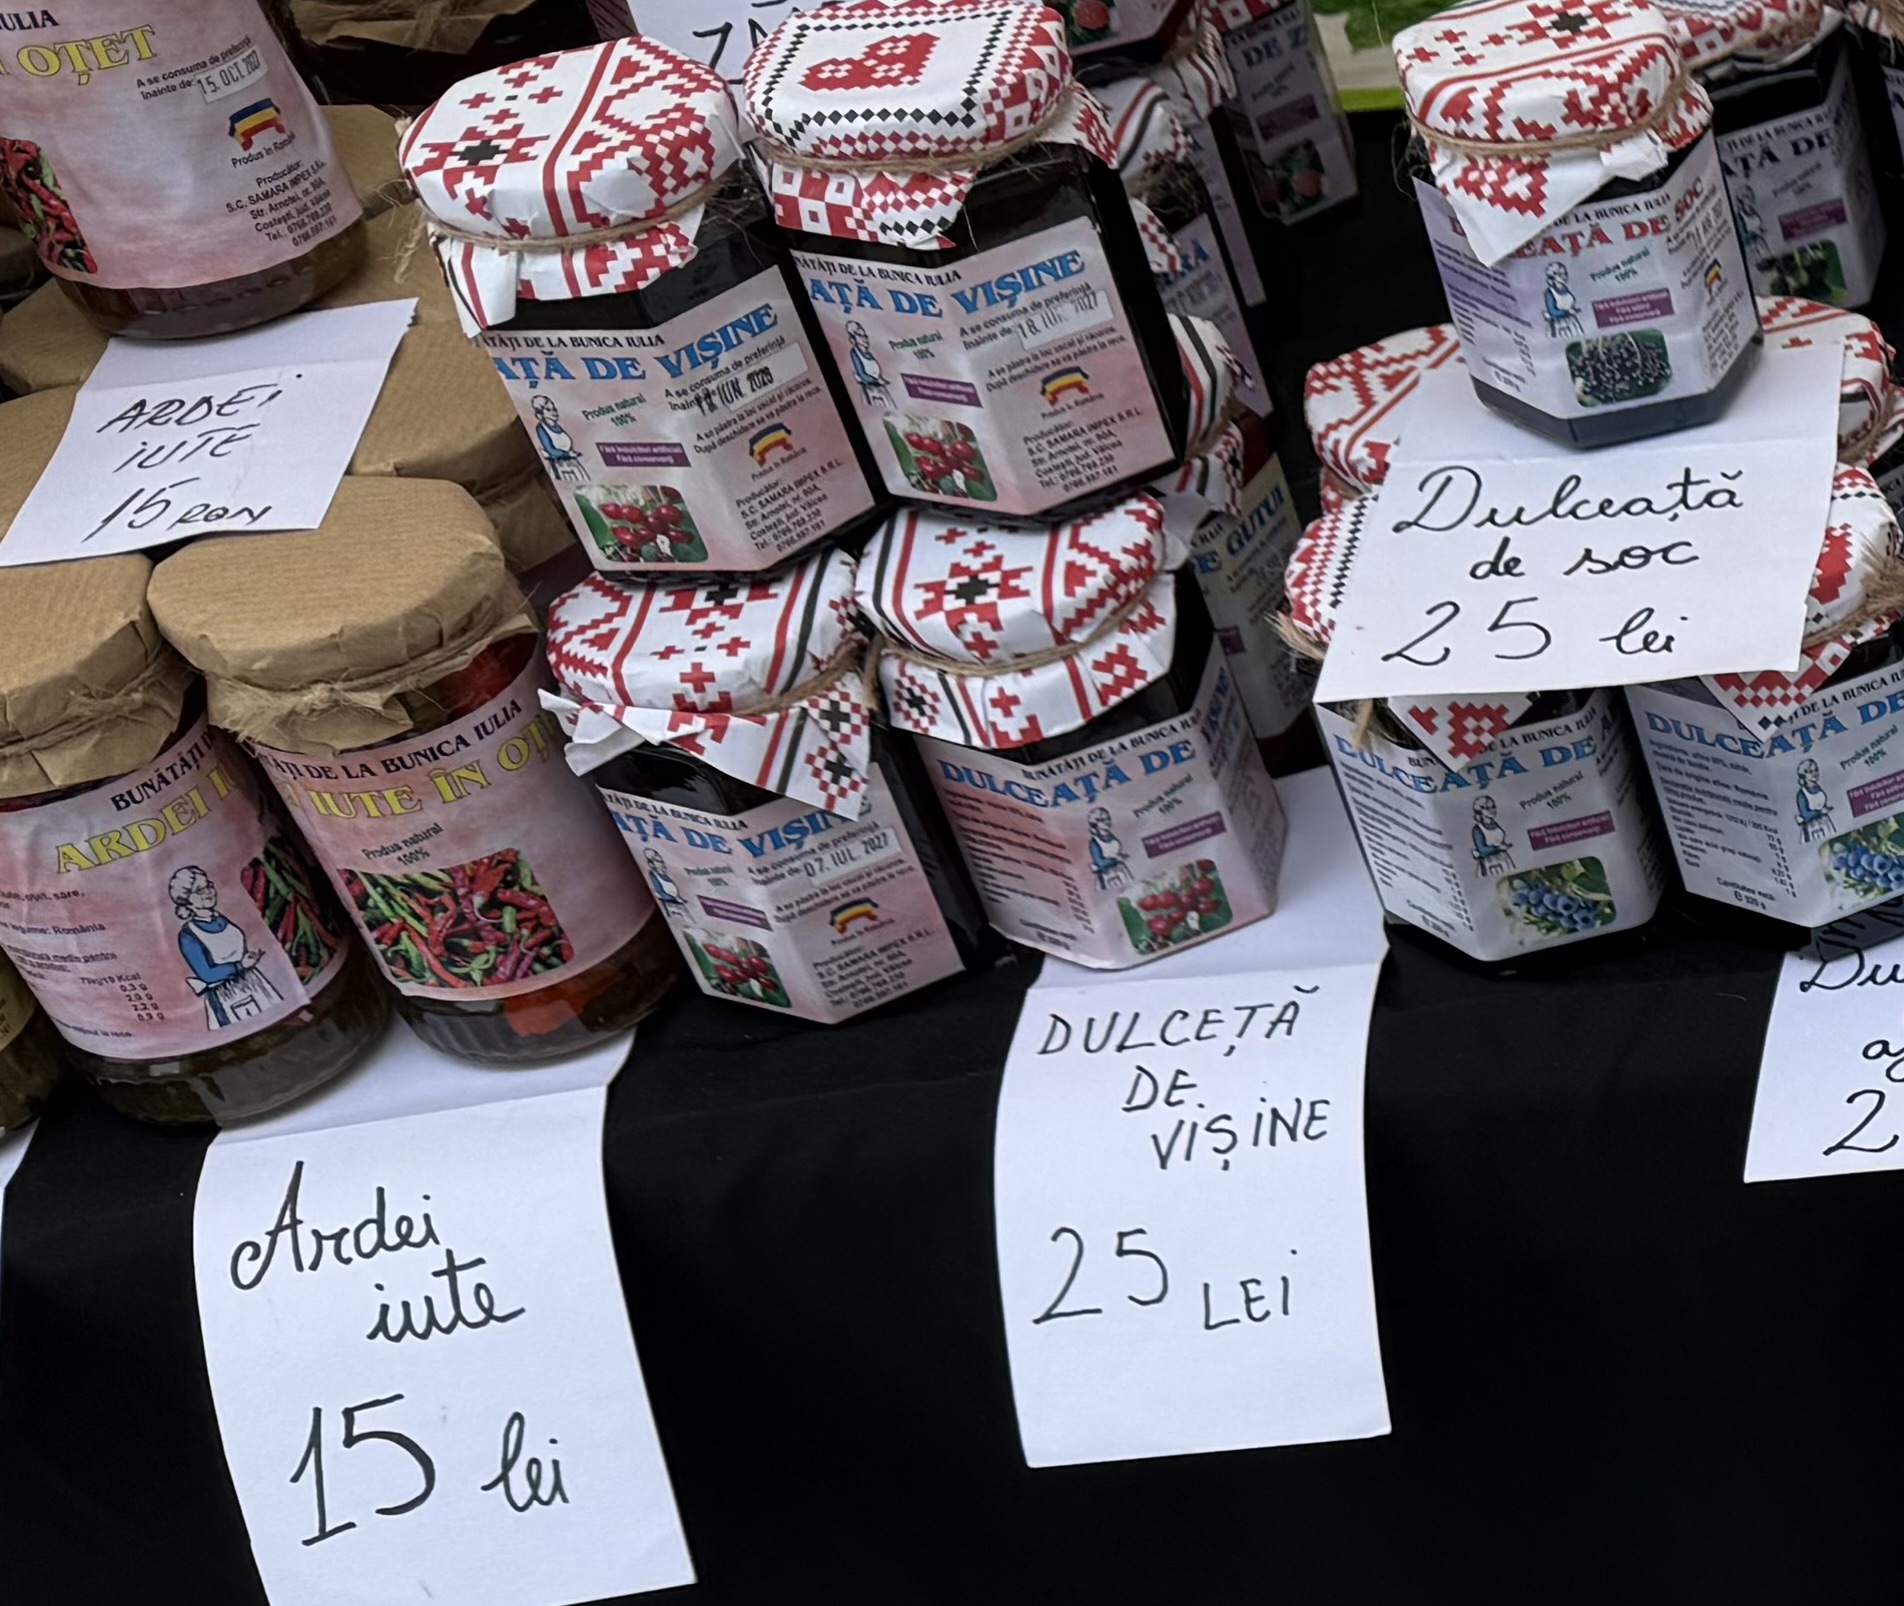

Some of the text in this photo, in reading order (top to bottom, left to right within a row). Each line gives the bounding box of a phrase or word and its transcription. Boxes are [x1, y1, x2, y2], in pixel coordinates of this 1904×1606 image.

[16, 24, 157, 87] OȚET
[888, 248, 1086, 319] DE VIȘINE
[580, 302, 780, 382] DE VIȘINE
[625, 333, 666, 349] IULIA
[80, 476, 274, 543] 15 RON
[1391, 464, 1745, 534] Dulceață
[1469, 535, 1701, 581] de soc
[1380, 596, 1690, 667] 25 lei
[382, 698, 525, 774] BUNICA IULIA
[1645, 709, 1849, 760] DULCEAȚĂ
[431, 760, 493, 805] ÎN
[937, 739, 1197, 810] DULCEAȚĂ DE
[56, 790, 210, 875] ARDEI
[1036, 984, 1322, 1058] DULCEȚĂ
[1121, 1064, 1198, 1113] DE
[229, 1160, 440, 1290] Ardei
[366, 1247, 527, 1343] iute
[1031, 1226, 1170, 1325] 25
[288, 1393, 571, 1547] 15 lei
